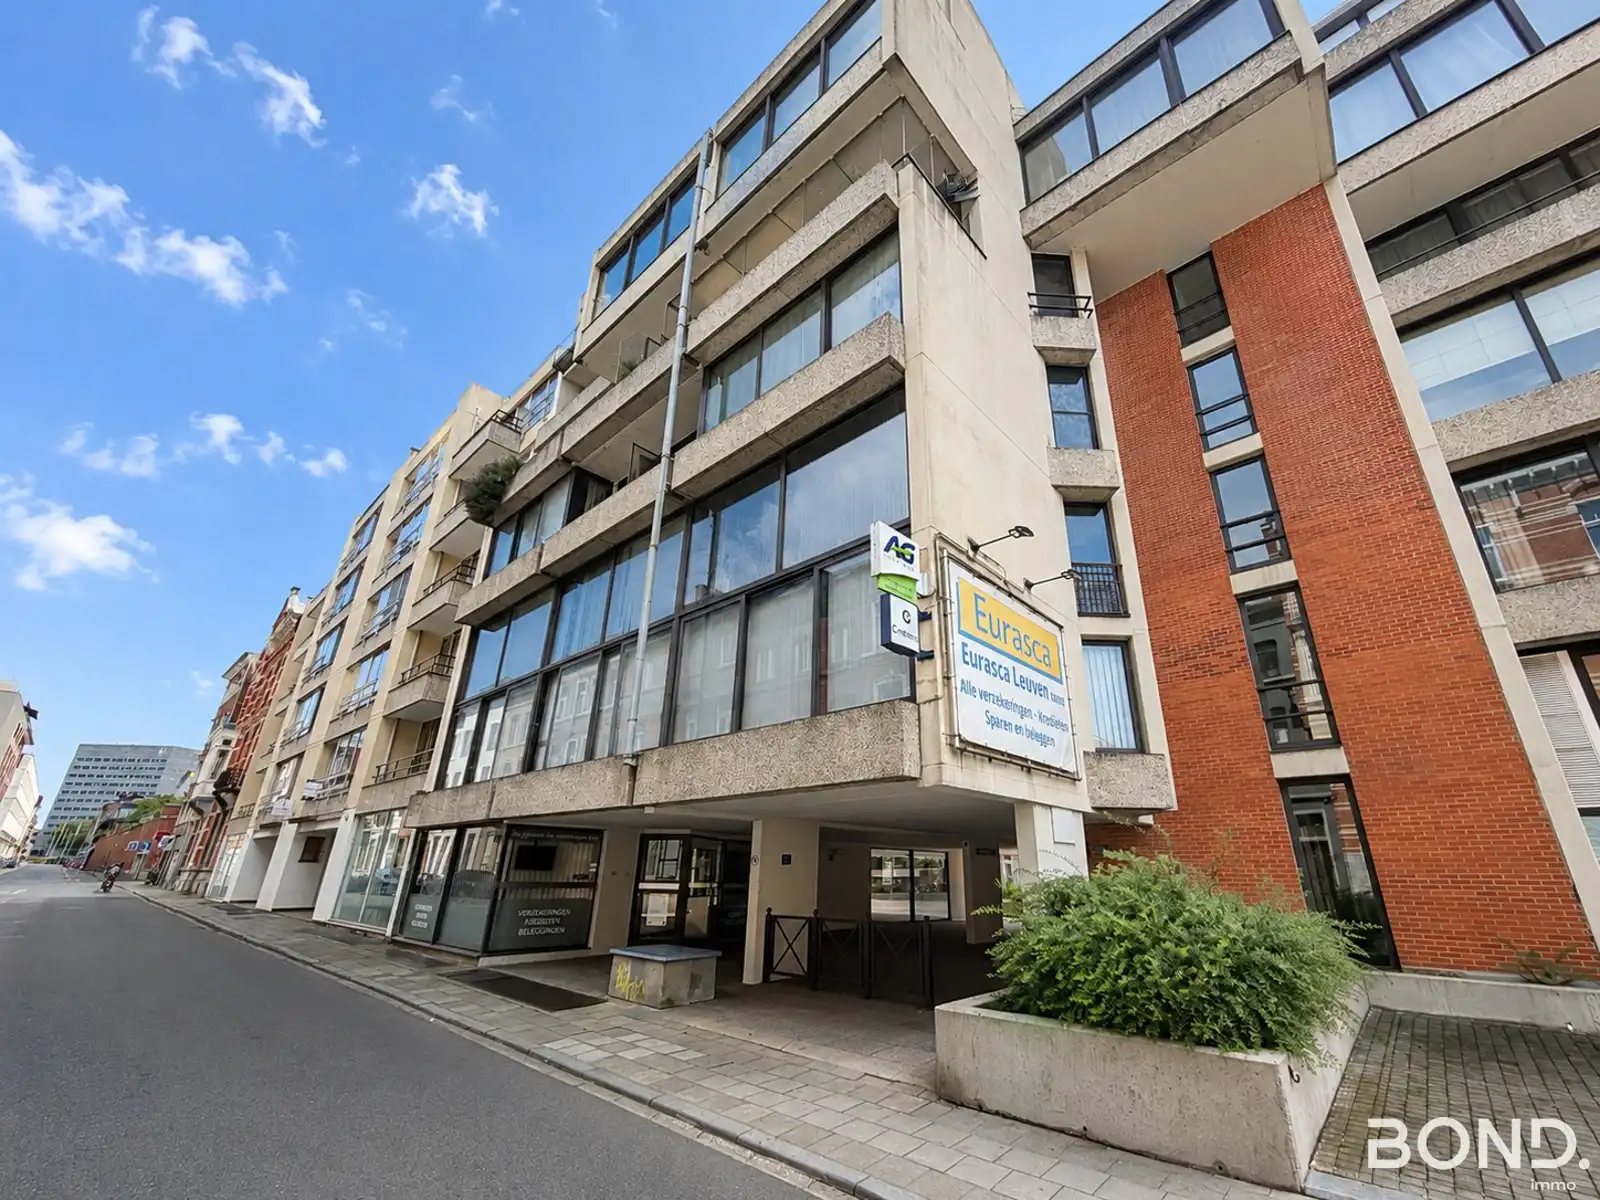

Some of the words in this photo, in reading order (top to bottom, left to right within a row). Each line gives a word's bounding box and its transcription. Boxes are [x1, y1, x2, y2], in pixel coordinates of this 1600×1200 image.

[883, 535, 915, 565] AG
[973, 592, 1052, 669] Eurasca
[961, 641, 1011, 684] Eurasca
[1012, 666, 1049, 698] Leuven
[960, 678, 977, 699] Alle
[984, 709, 1013, 733] Sparen
[1014, 724, 1025, 736] en
